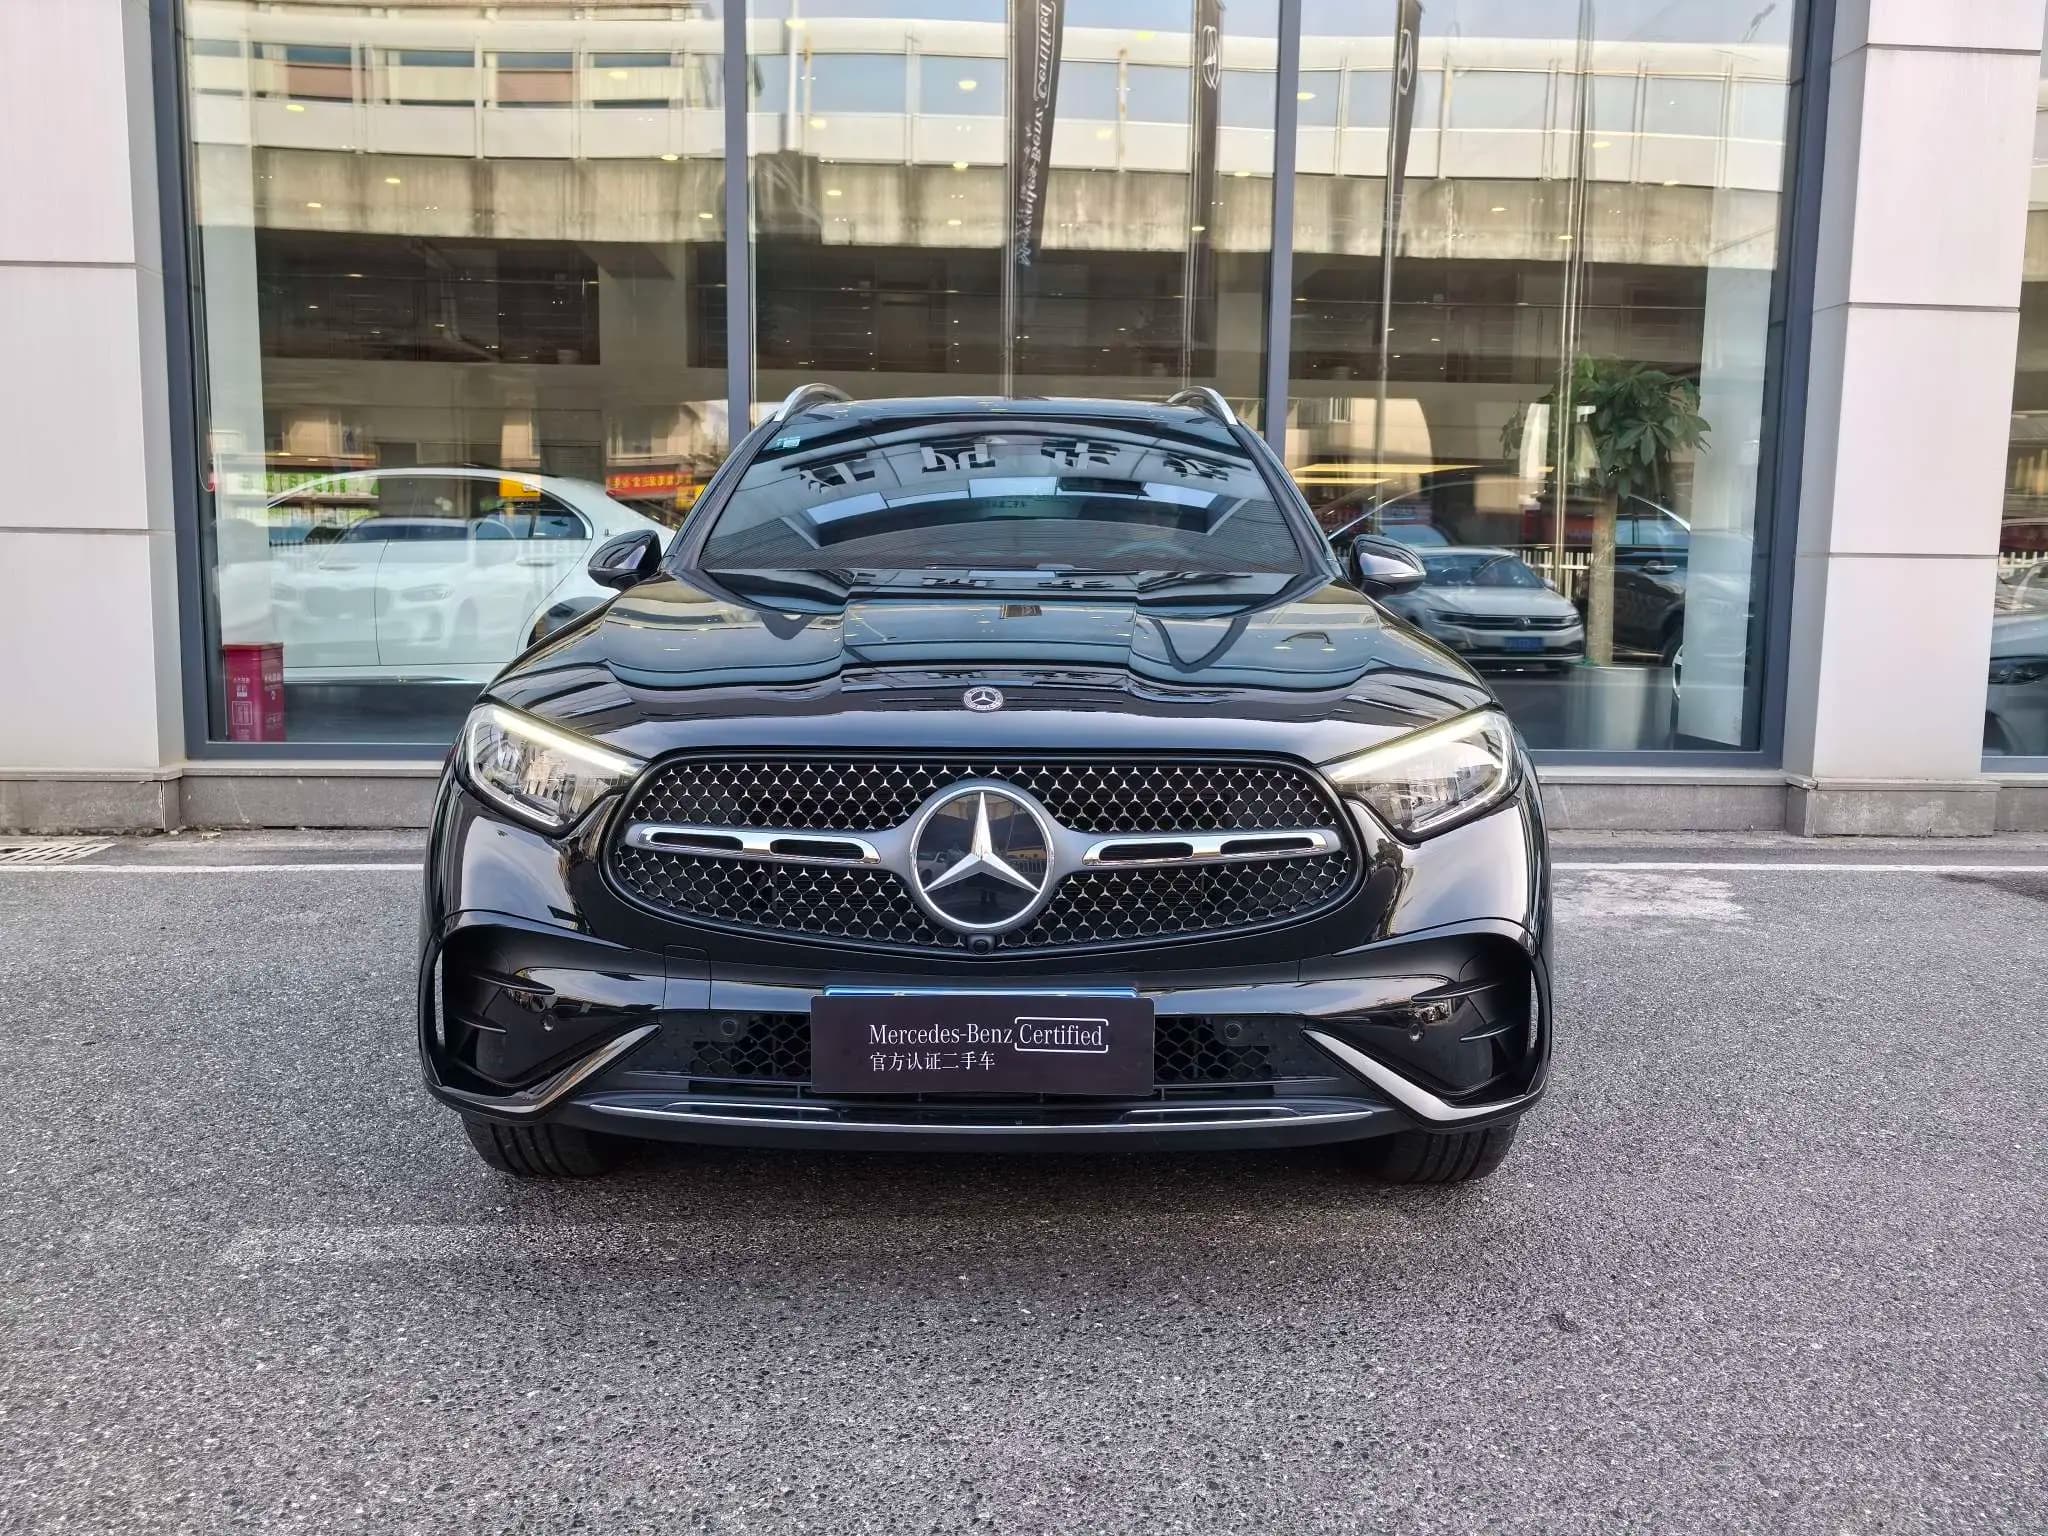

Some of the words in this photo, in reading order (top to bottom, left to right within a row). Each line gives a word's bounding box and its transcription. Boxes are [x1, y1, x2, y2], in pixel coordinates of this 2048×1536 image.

[869, 1023, 1013, 1045] Mercedes-Benz
[1019, 1023, 1103, 1046] Certified
[870, 1051, 995, 1071] 官方认证二手车
